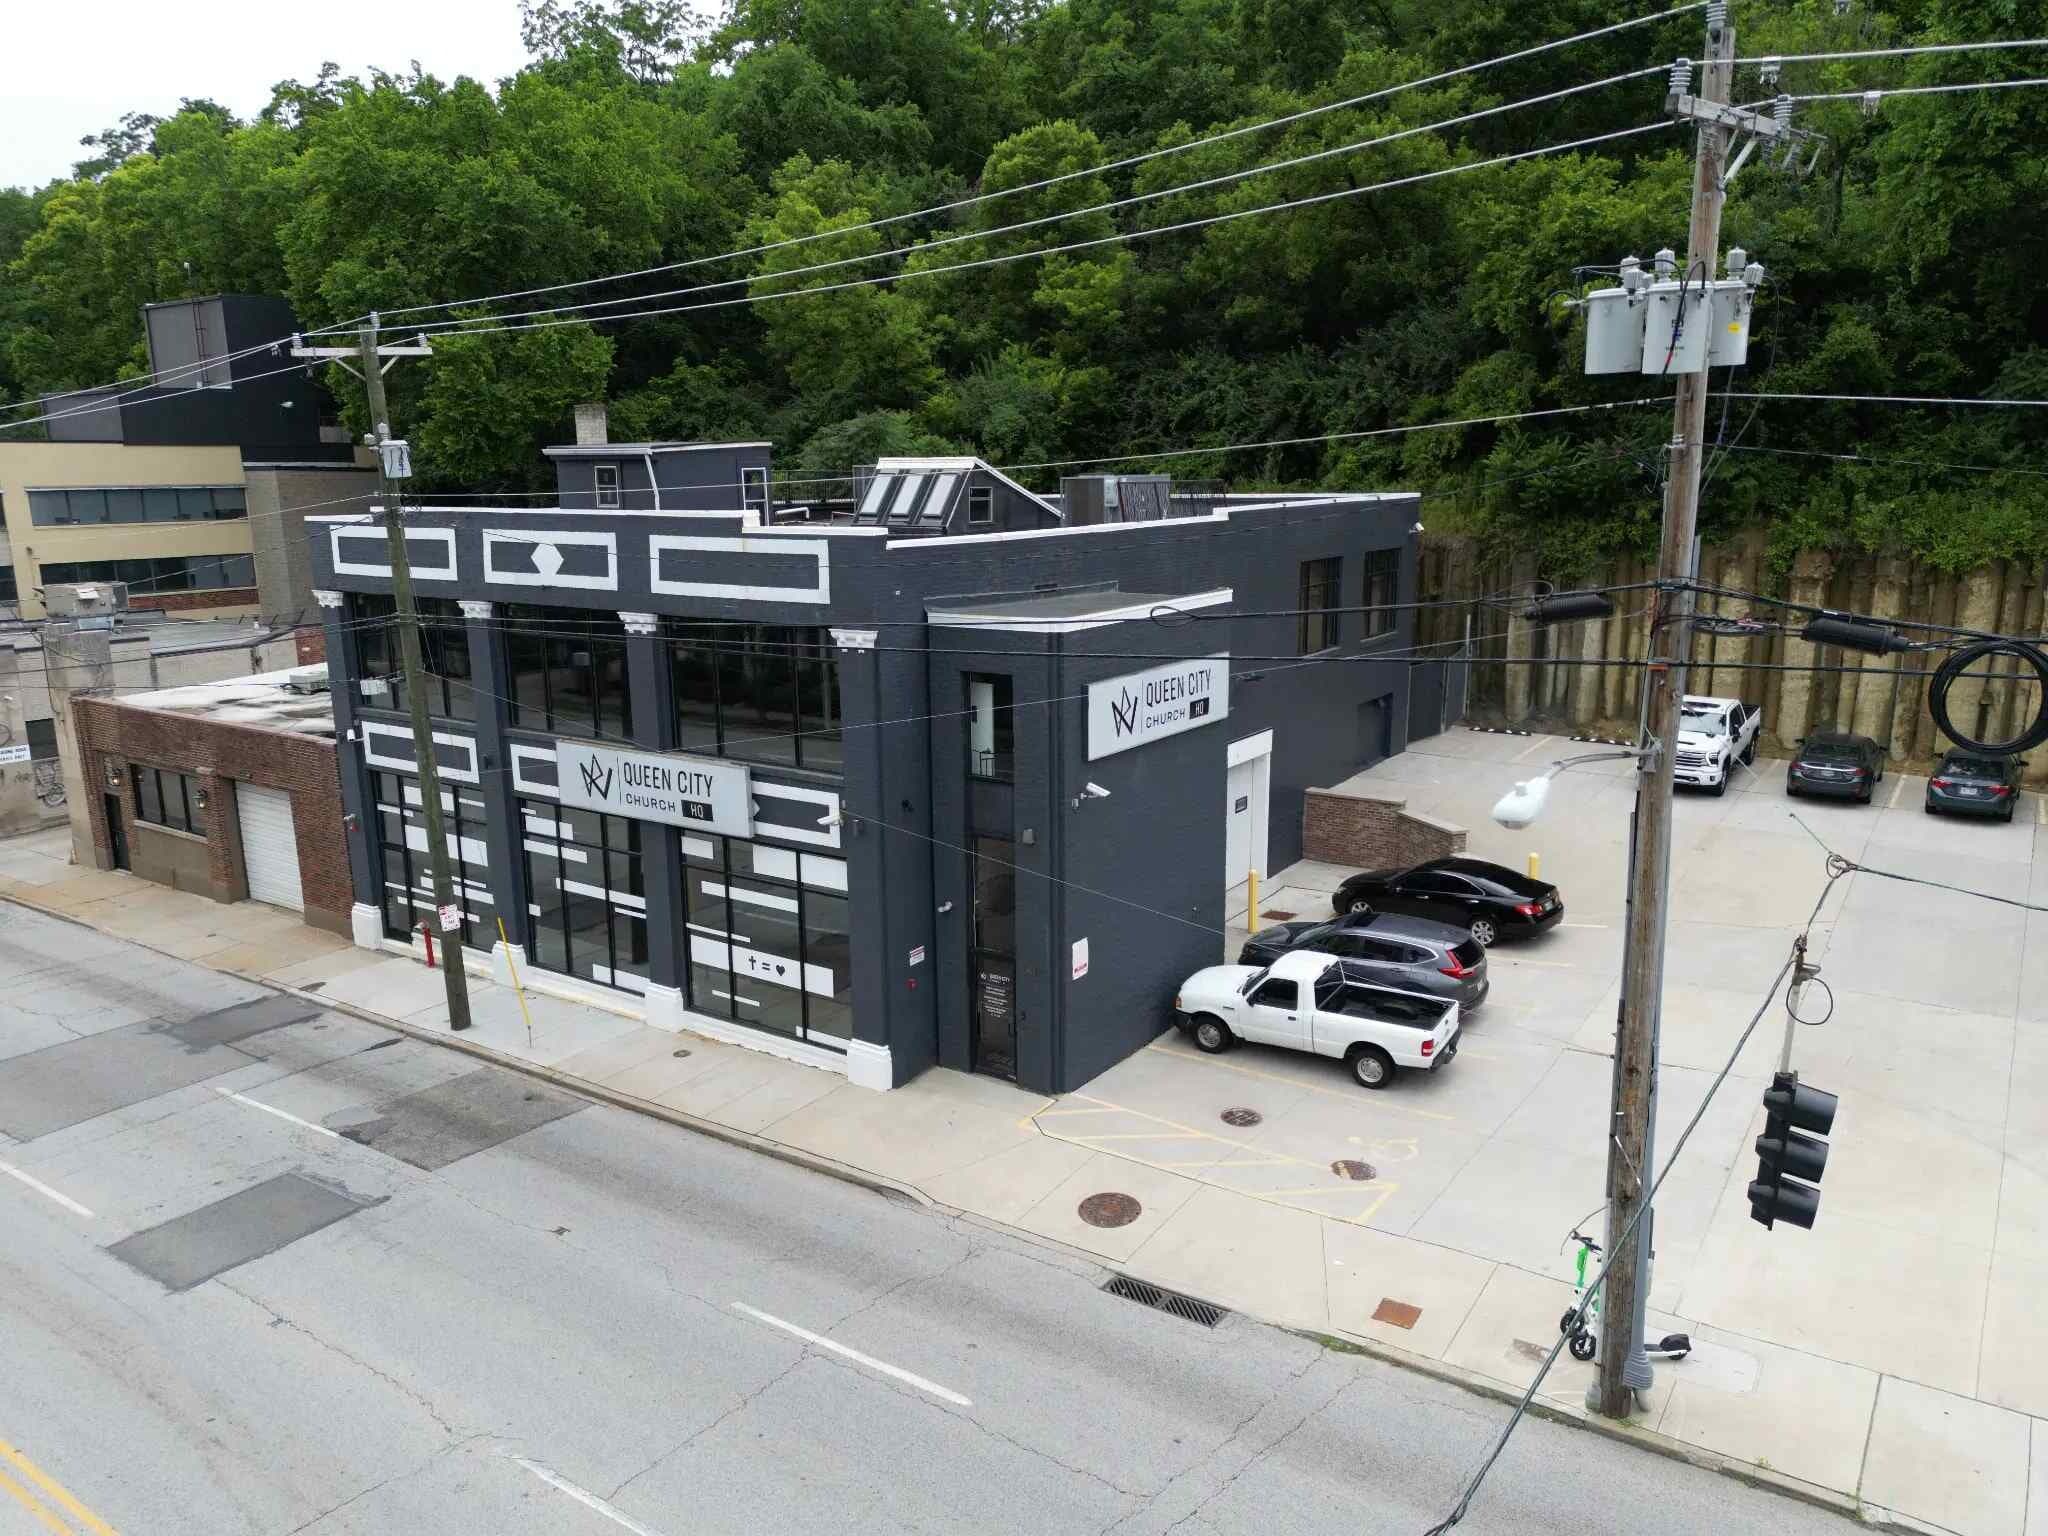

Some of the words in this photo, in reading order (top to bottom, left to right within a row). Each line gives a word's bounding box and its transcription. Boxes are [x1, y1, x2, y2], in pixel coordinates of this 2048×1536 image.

[1146, 677, 1185, 707] QUEEN
[1188, 669, 1211, 694] CITY
[1146, 708, 1185, 728] CHURCH
[624, 762, 672, 791] QUEEN
[678, 771, 713, 797] CITY
[625, 793, 675, 813] CHURCH
